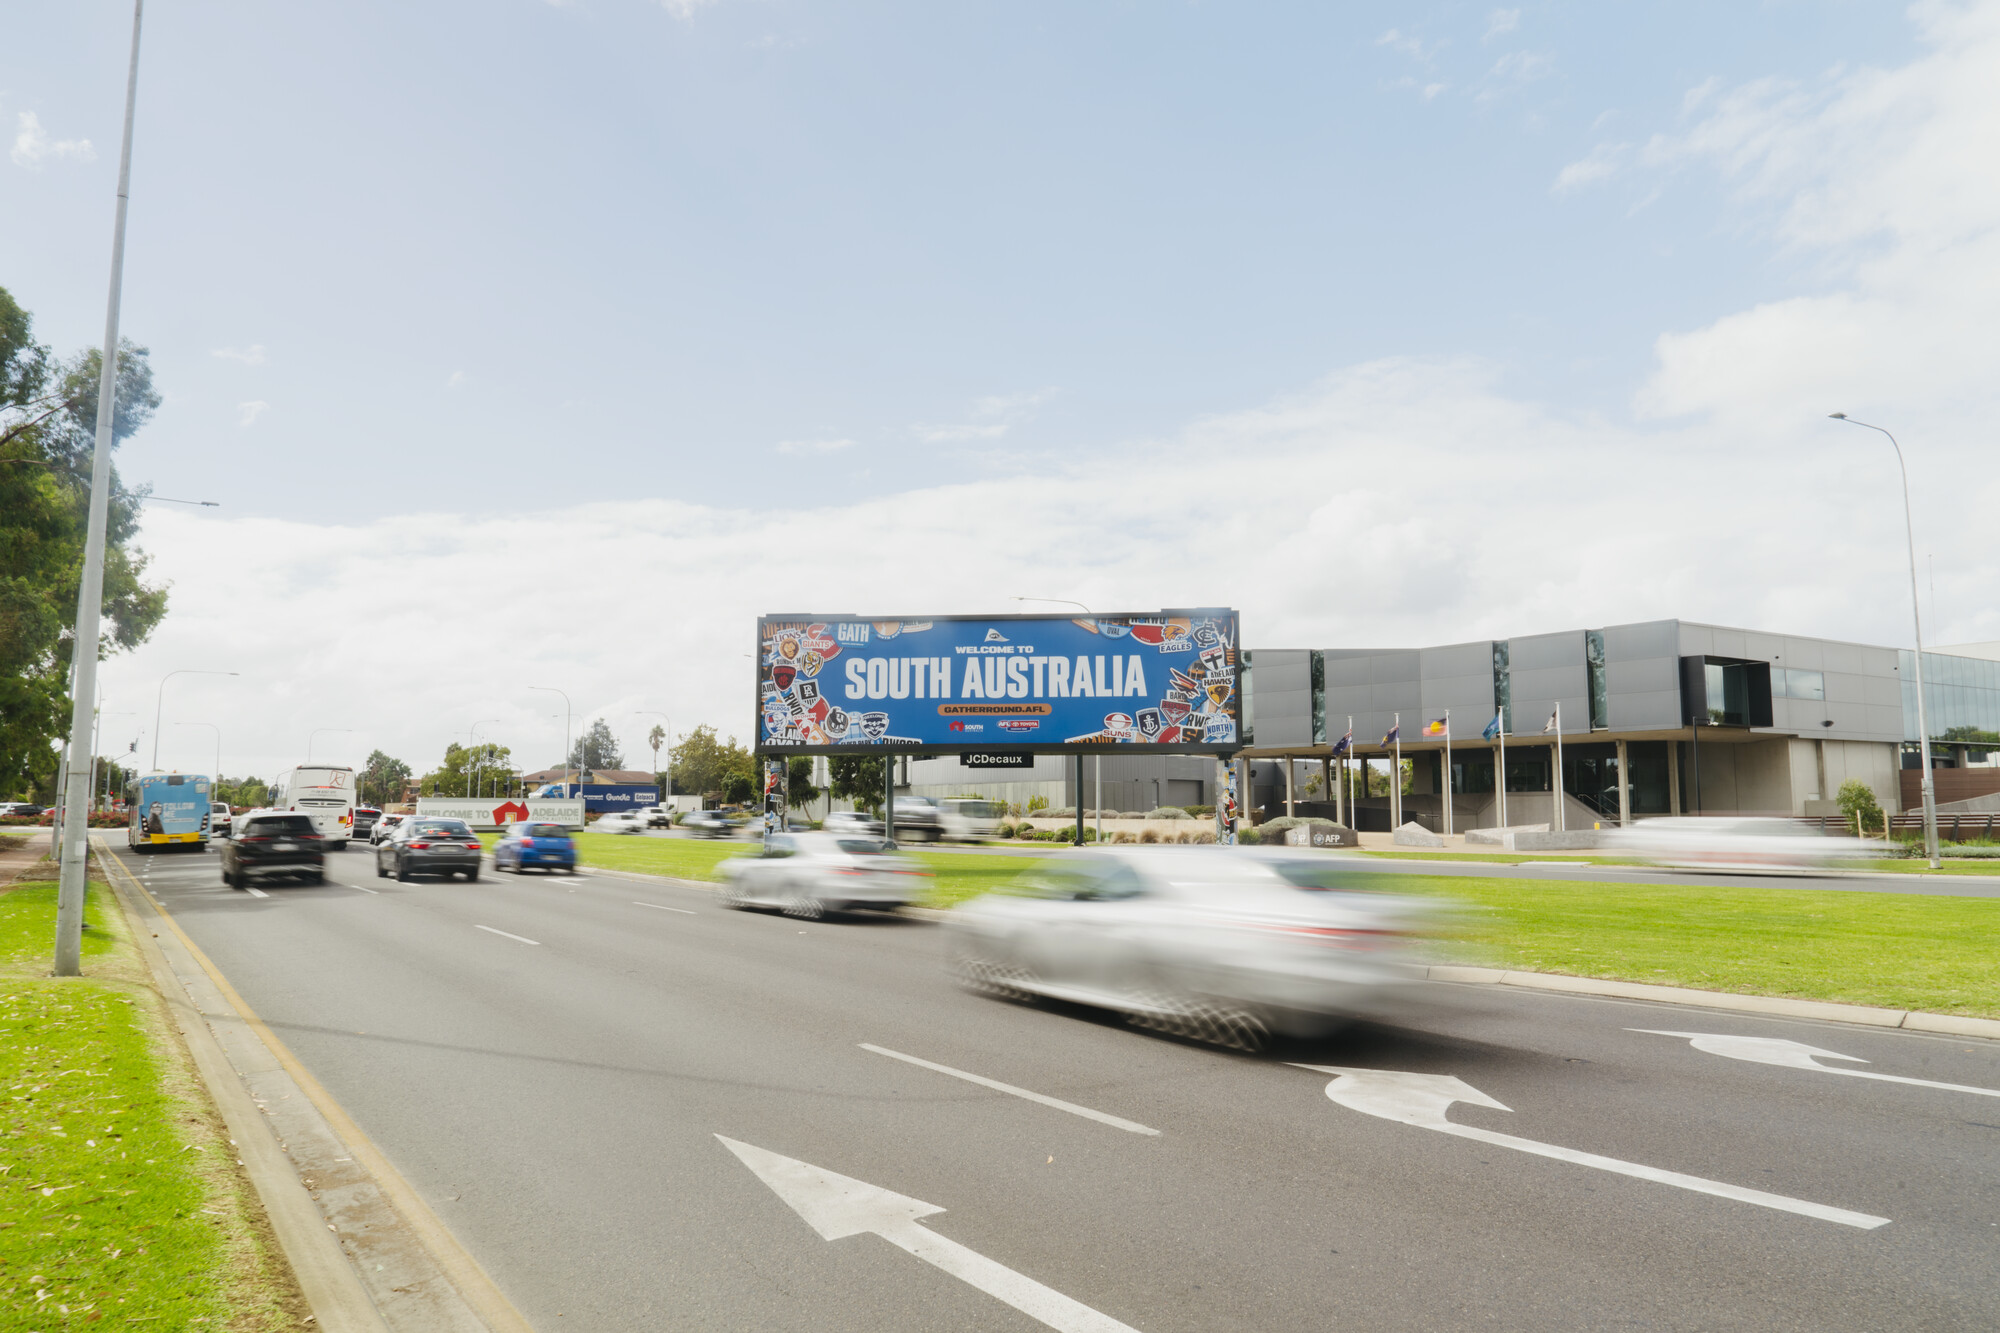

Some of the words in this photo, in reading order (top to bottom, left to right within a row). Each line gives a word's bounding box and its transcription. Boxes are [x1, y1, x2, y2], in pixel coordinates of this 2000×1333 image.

[838, 623, 869, 642] GATH
[1107, 626, 1120, 635] OVAL
[774, 633, 801, 643] LIONS
[802, 640, 830, 648] GIANTS
[1161, 643, 1191, 652] EAGLES
[955, 646, 1014, 654] WELCOME
[1017, 645, 1034, 653] TO
[845, 656, 951, 699] SOUTH
[961, 655, 1147, 699] AUSTRALIA
[1203, 677, 1232, 686] HAWKS
[944, 706, 1045, 714] GATHERROUND.AFL
[1103, 729, 1132, 738] SUNS
[1207, 723, 1230, 735] NORTH
[966, 755, 1022, 763] JCDecaux
[606, 793, 631, 801] Gundle
[163, 802, 195, 810] FOLLOW
[421, 809, 473, 819] WELCOME
[476, 810, 489, 818] TO
[532, 808, 579, 816] ADELAIDE
[1325, 834, 1340, 843] AFP
